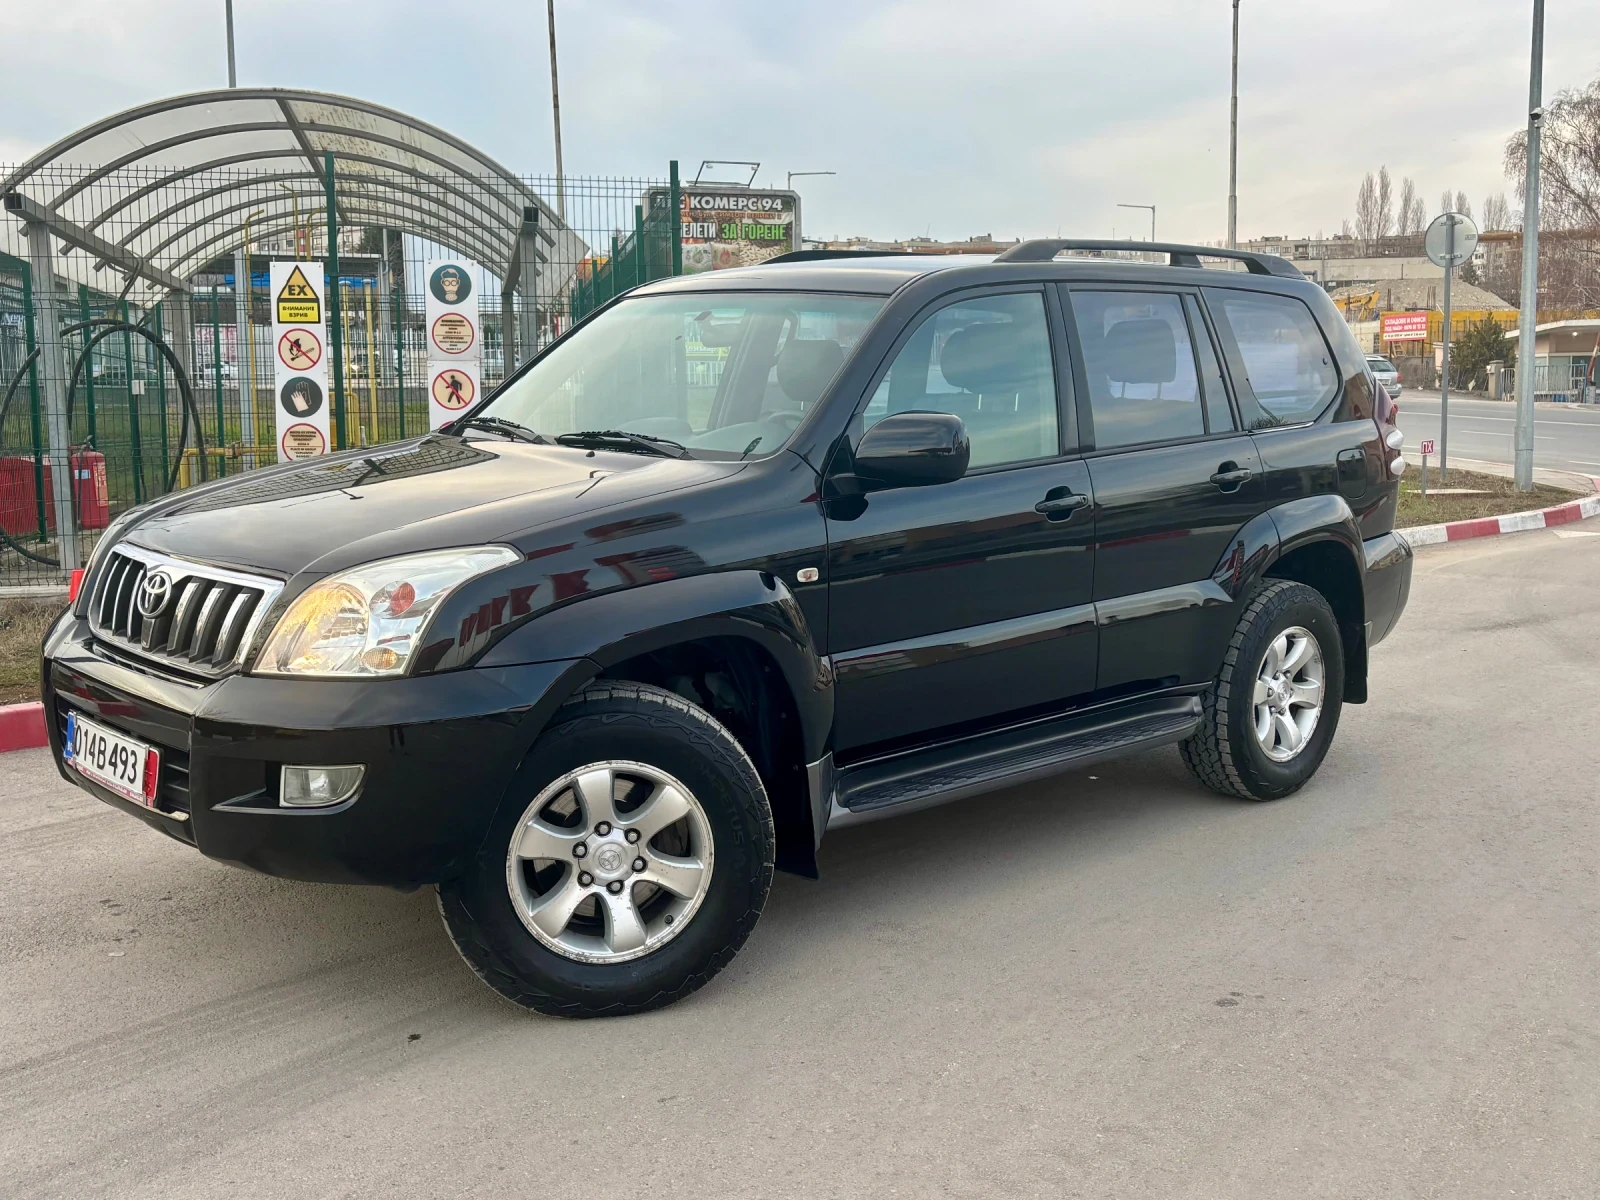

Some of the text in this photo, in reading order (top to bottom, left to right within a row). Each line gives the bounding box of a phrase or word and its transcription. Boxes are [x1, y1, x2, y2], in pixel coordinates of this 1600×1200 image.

[690, 196, 758, 211] КОМЕРС
[762, 197, 783, 211] 94
[680, 222, 716, 238] ЕЛЕТИ
[721, 223, 738, 239] ЗА
[742, 223, 787, 240] ГОРЕНЕ
[288, 284, 308, 296] EX
[1422, 441, 1433, 453] ПХ
